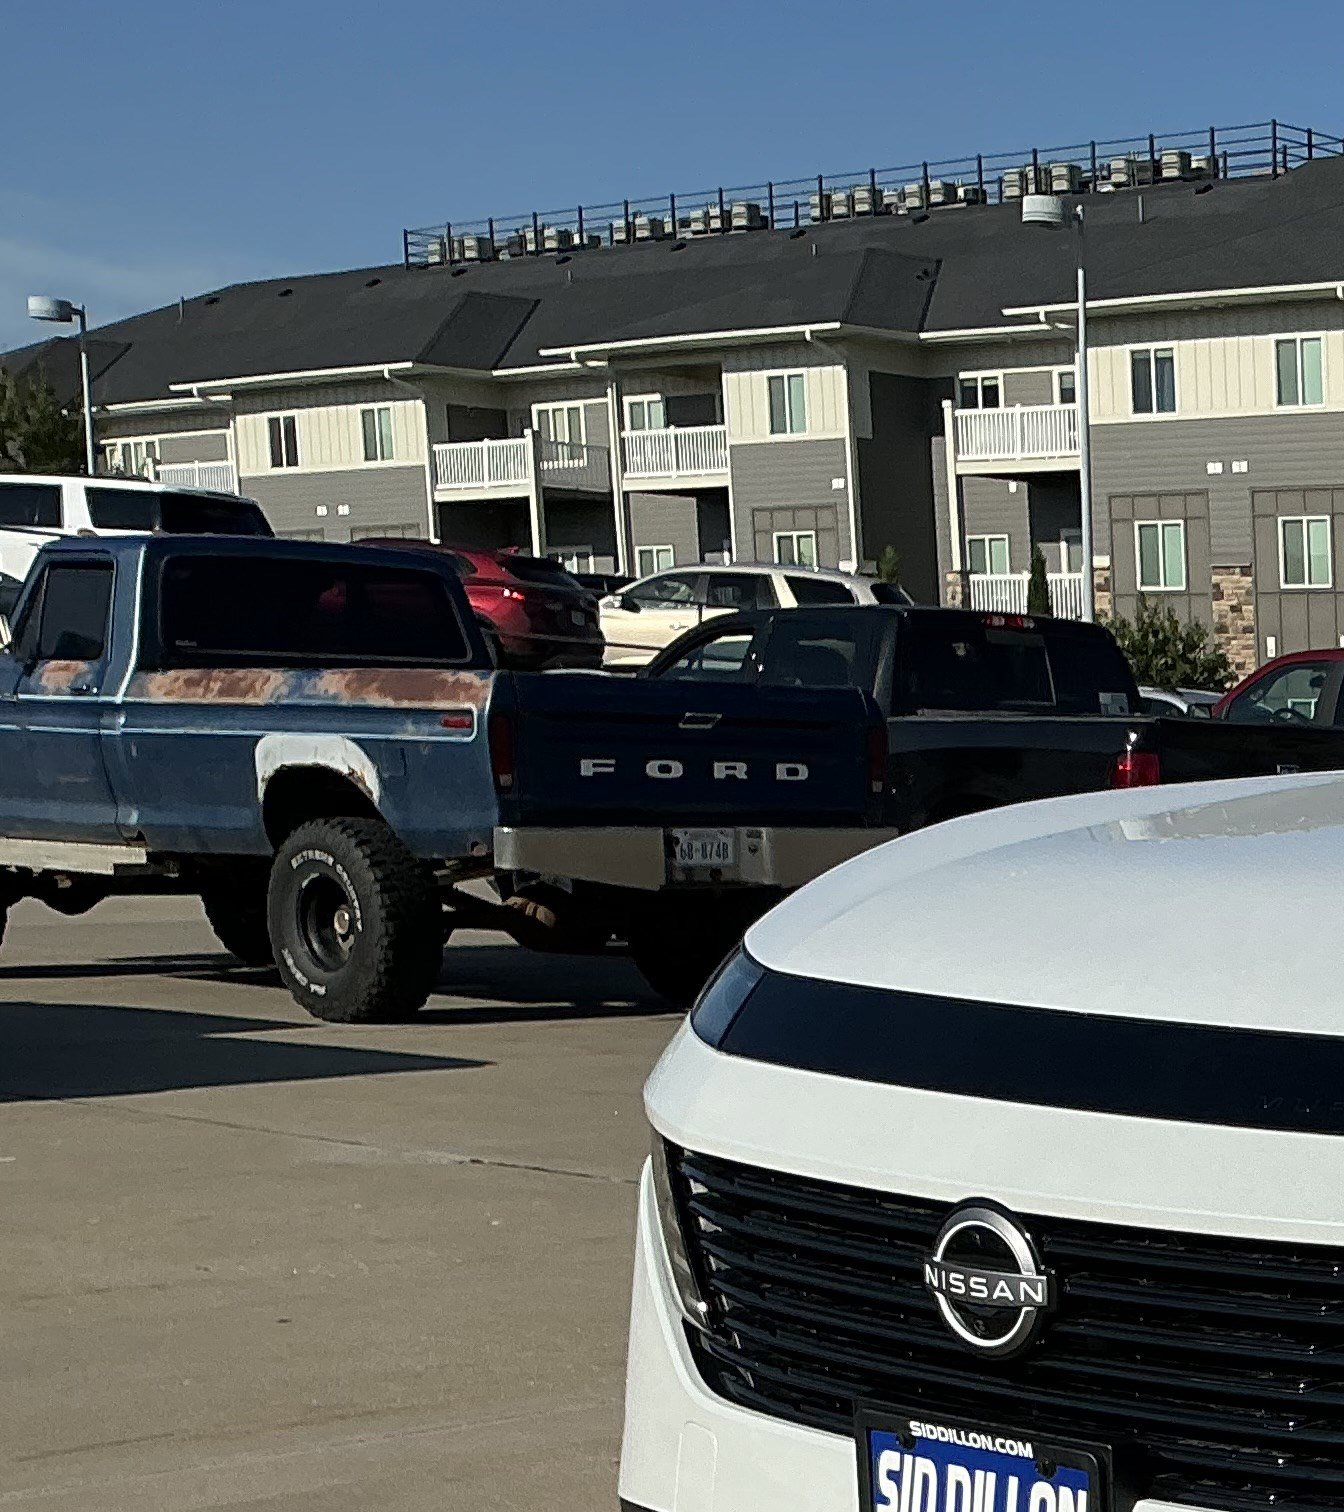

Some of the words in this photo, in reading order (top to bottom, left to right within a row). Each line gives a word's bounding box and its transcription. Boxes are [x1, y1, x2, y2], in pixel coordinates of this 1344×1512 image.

[580, 758, 809, 781] FORD
[924, 1262, 1045, 1303] NISSAN
[908, 1420, 1034, 1459] SIDDILLON.COM
